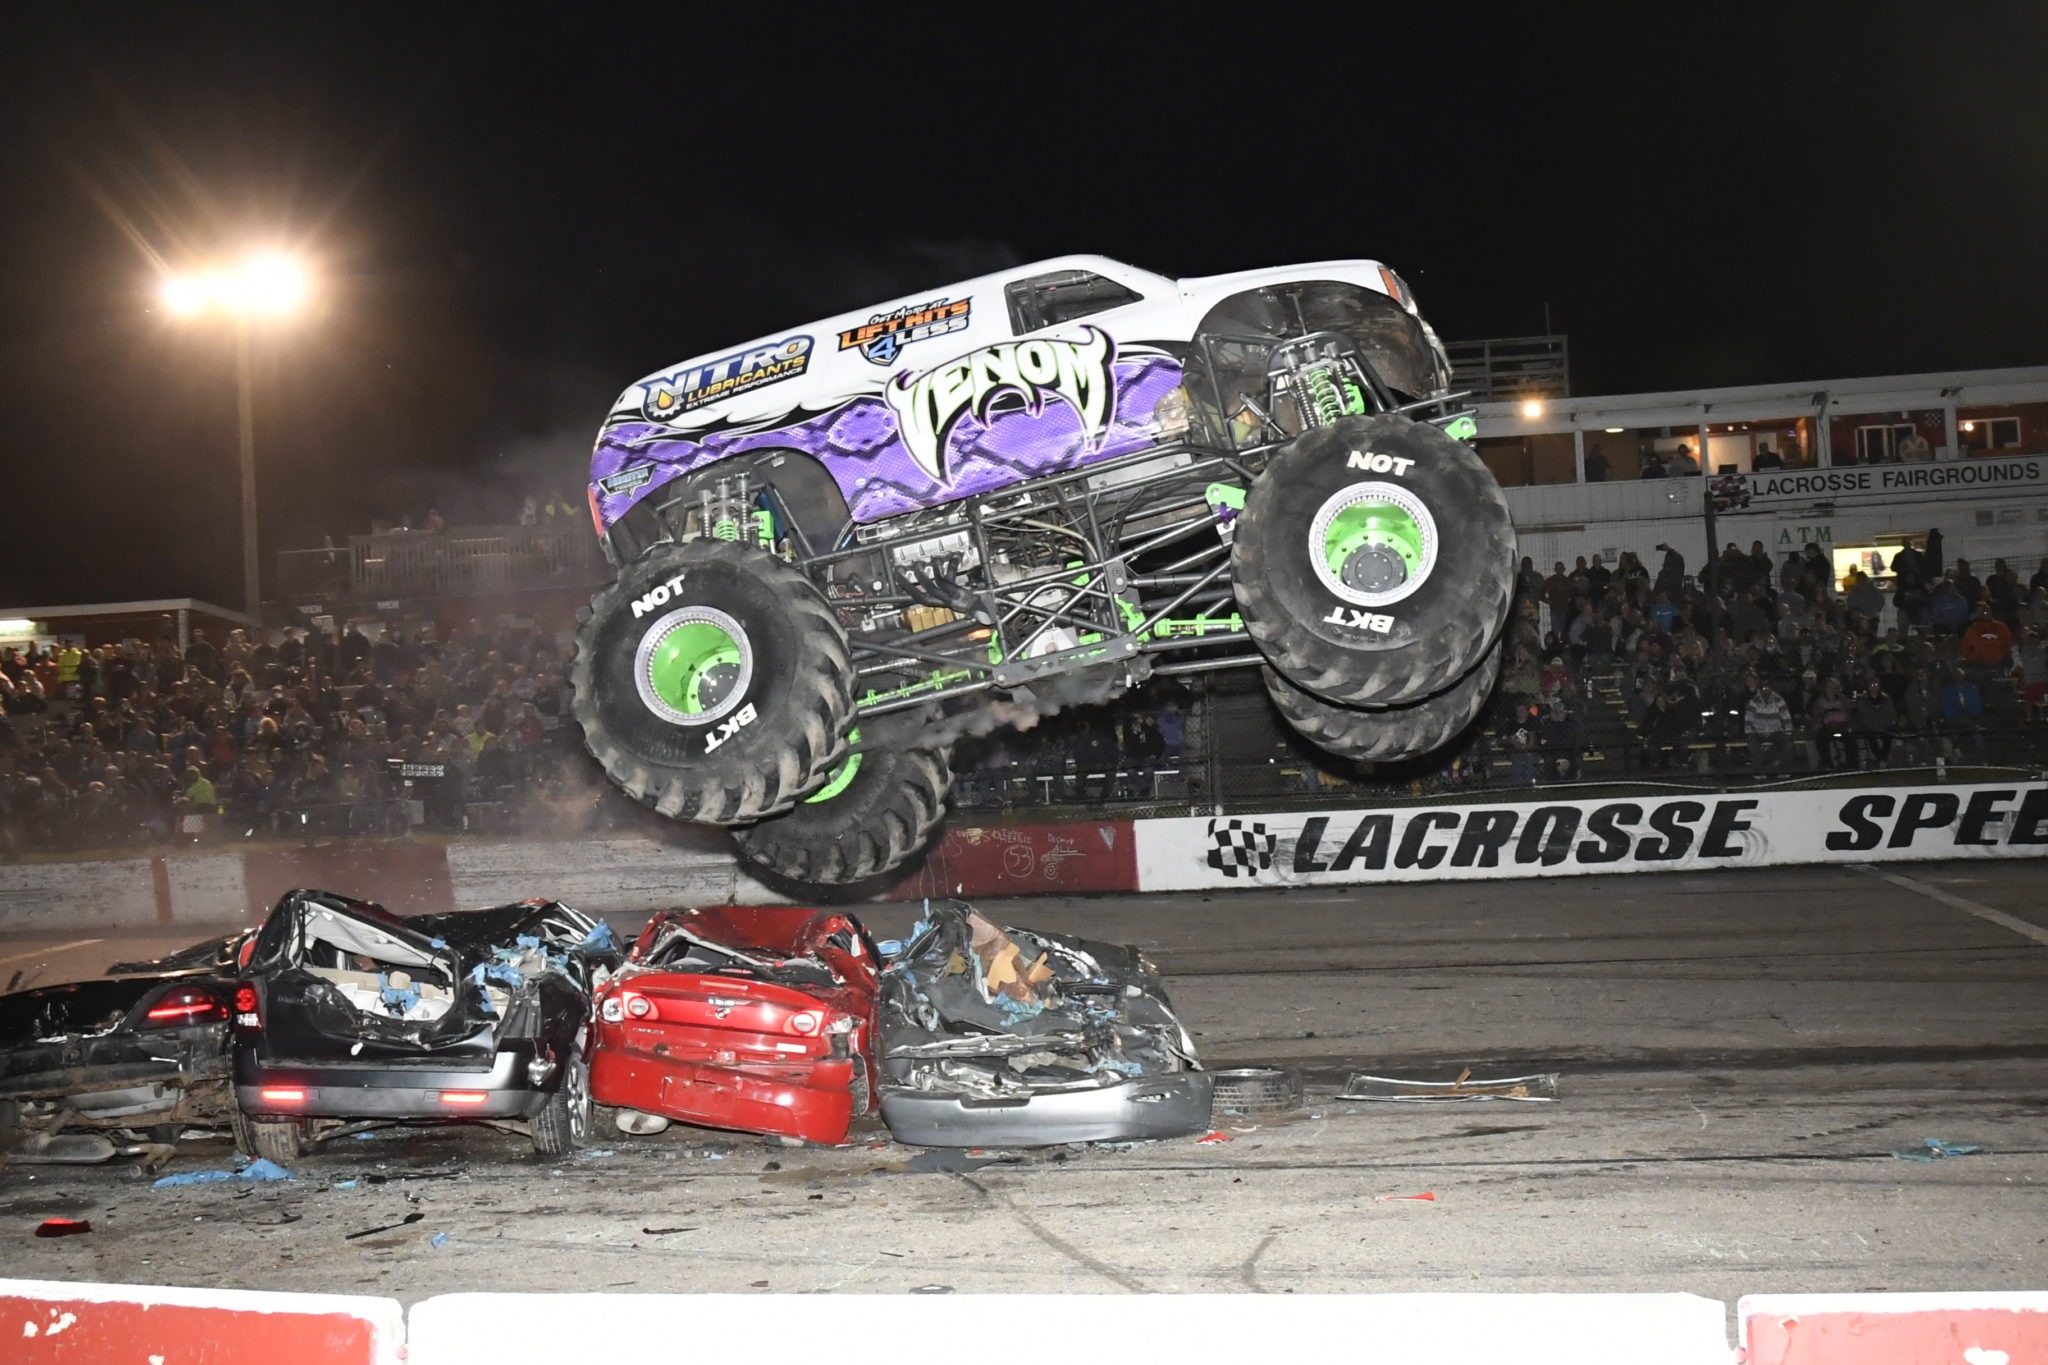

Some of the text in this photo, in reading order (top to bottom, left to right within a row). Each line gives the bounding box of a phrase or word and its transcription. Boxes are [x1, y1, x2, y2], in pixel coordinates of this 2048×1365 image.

[841, 300, 969, 349] LIFT KITS
[867, 315, 968, 360] 4 LESS
[648, 336, 810, 404] NITRO
[686, 367, 803, 410] EXTREME PERFORMANCE
[687, 355, 805, 402] LUBRICANTS
[885, 326, 1112, 480] VENOM
[1346, 450, 1415, 477] NOT
[1752, 462, 2040, 496] LACROSSE FAIRGROUNDS
[1778, 526, 1833, 545] ATM
[630, 574, 685, 619] NOT
[1323, 606, 1395, 634] BKT
[704, 702, 758, 755] BKT
[1293, 789, 2048, 873] LACROSSE SPEE
